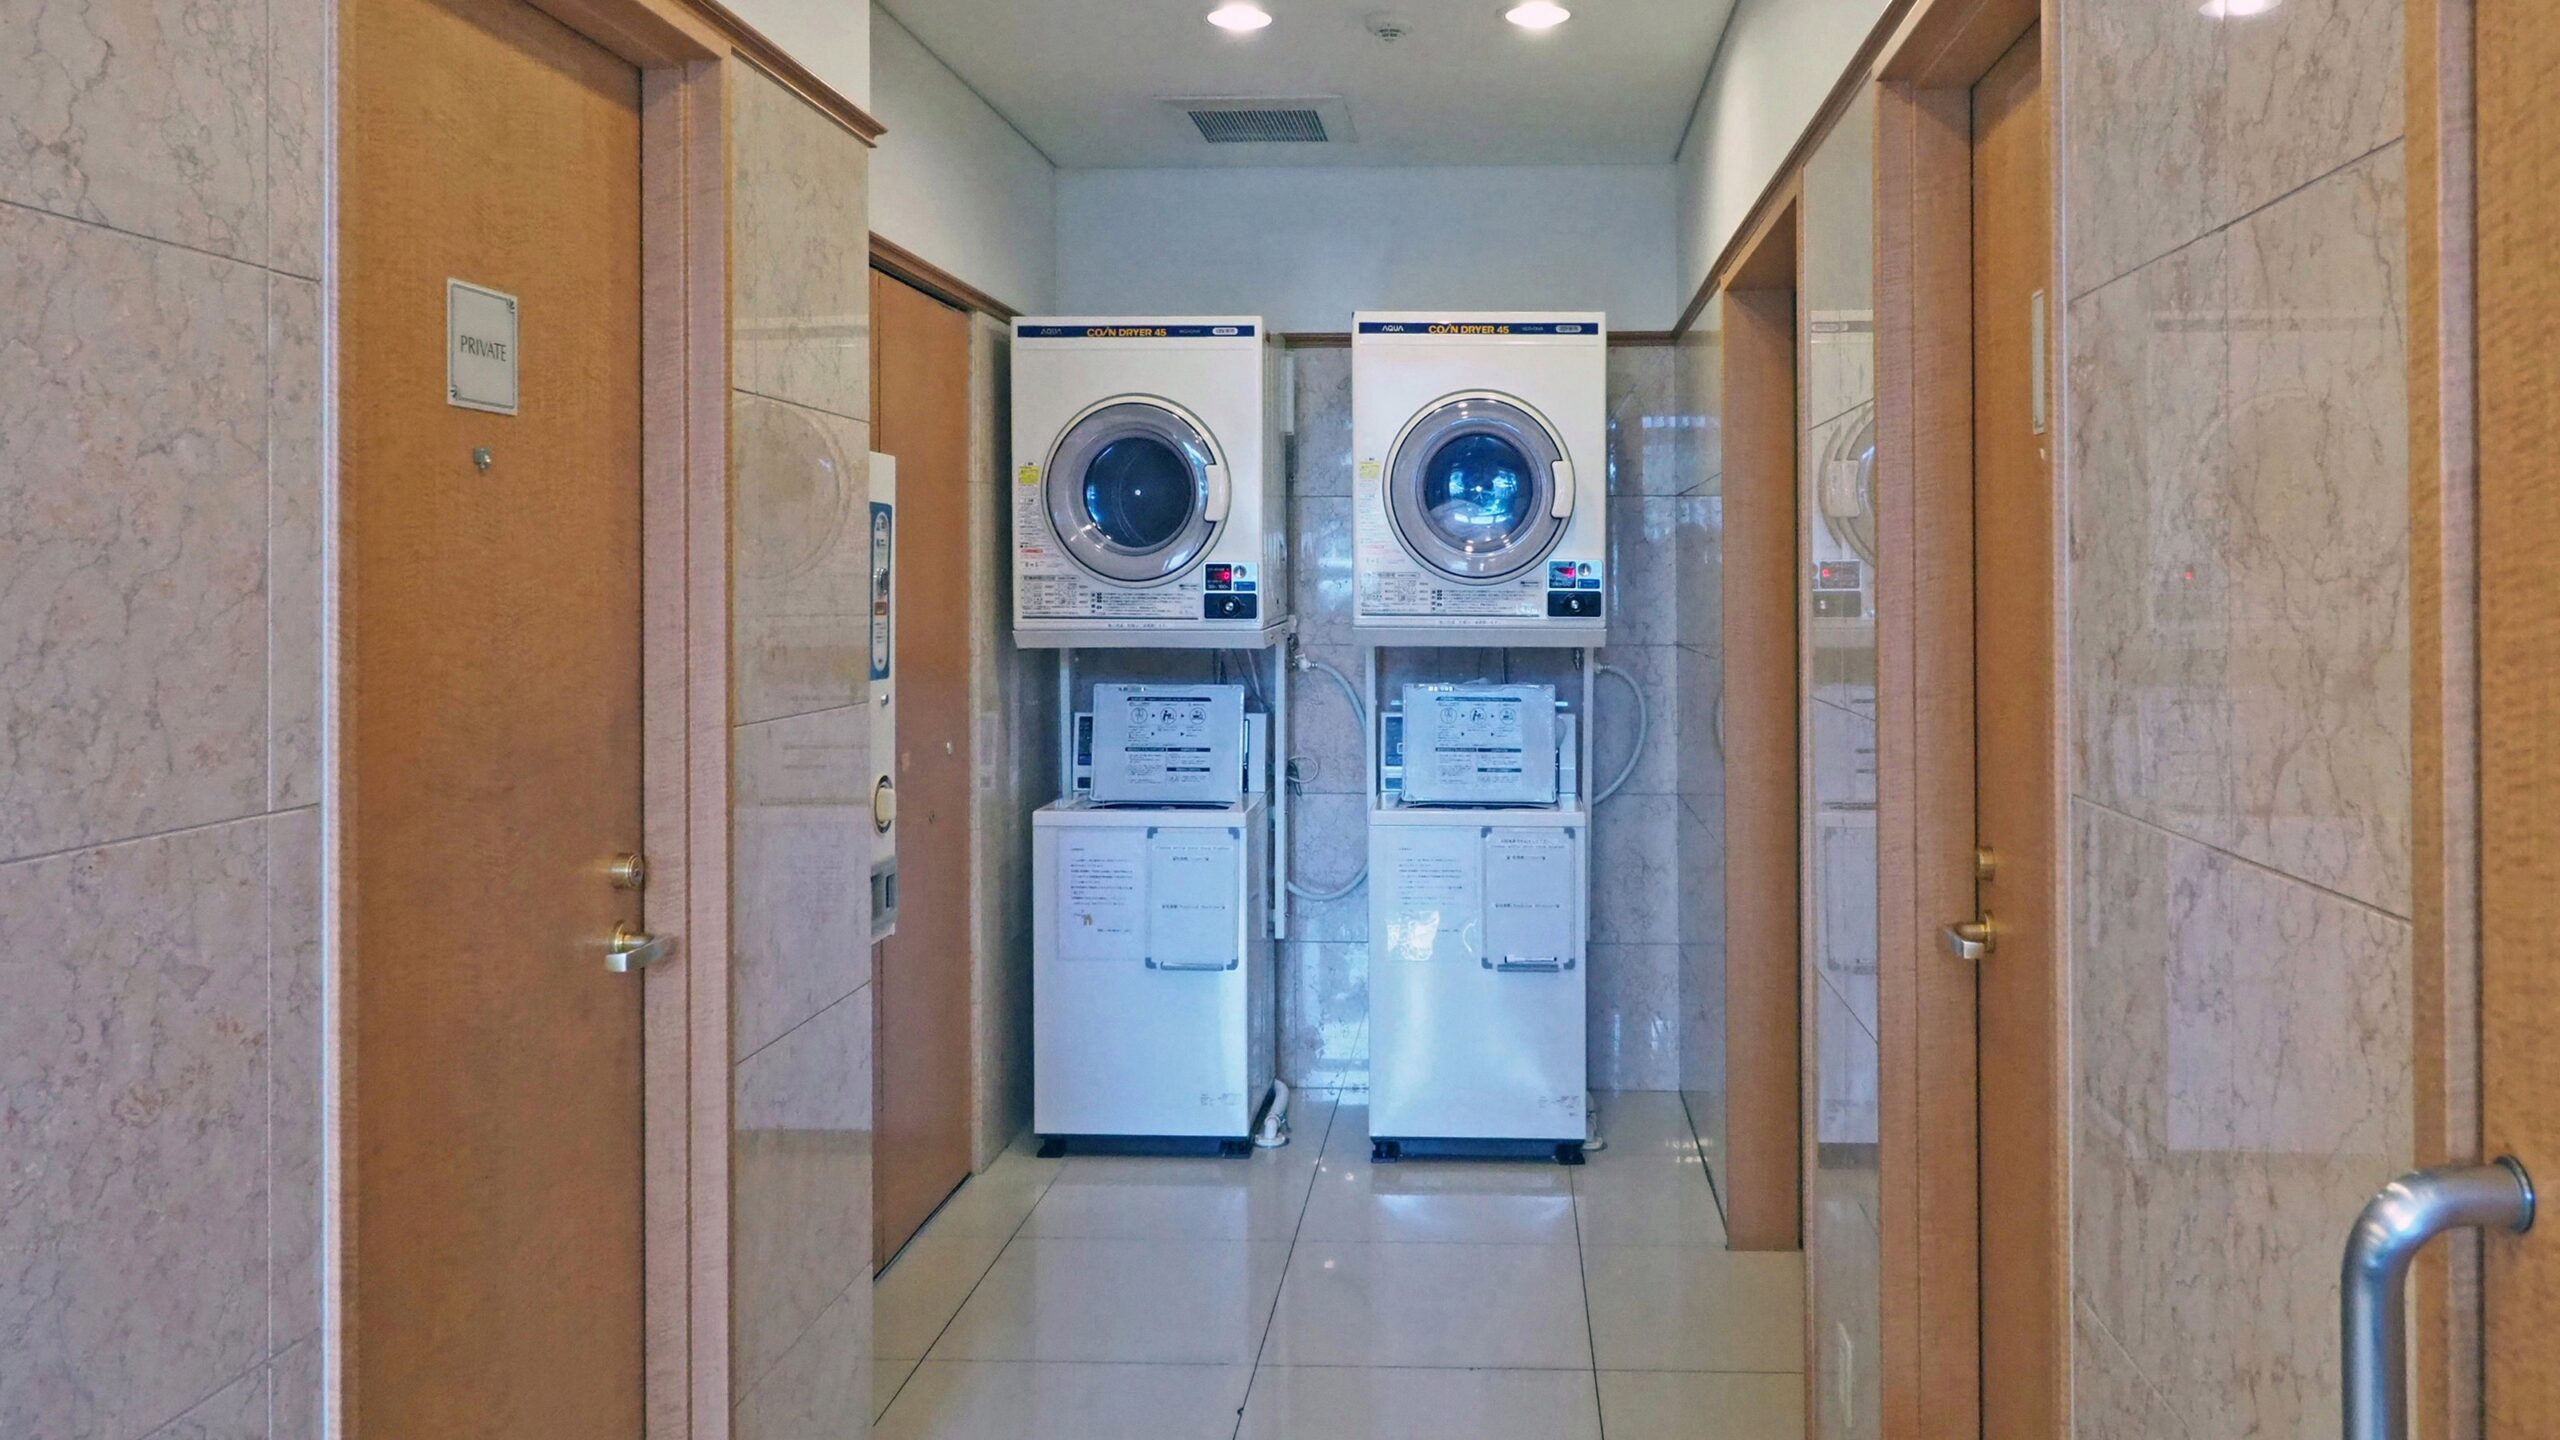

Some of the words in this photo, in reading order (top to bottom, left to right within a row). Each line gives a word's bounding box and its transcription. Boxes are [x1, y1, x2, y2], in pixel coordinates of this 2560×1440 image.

[1118, 328, 1153, 337] DRYER
[1154, 328, 1167, 337] 45
[1460, 325, 1496, 334] DRYER
[1496, 325, 1510, 334] 45
[460, 335, 507, 362] PRIVATE
